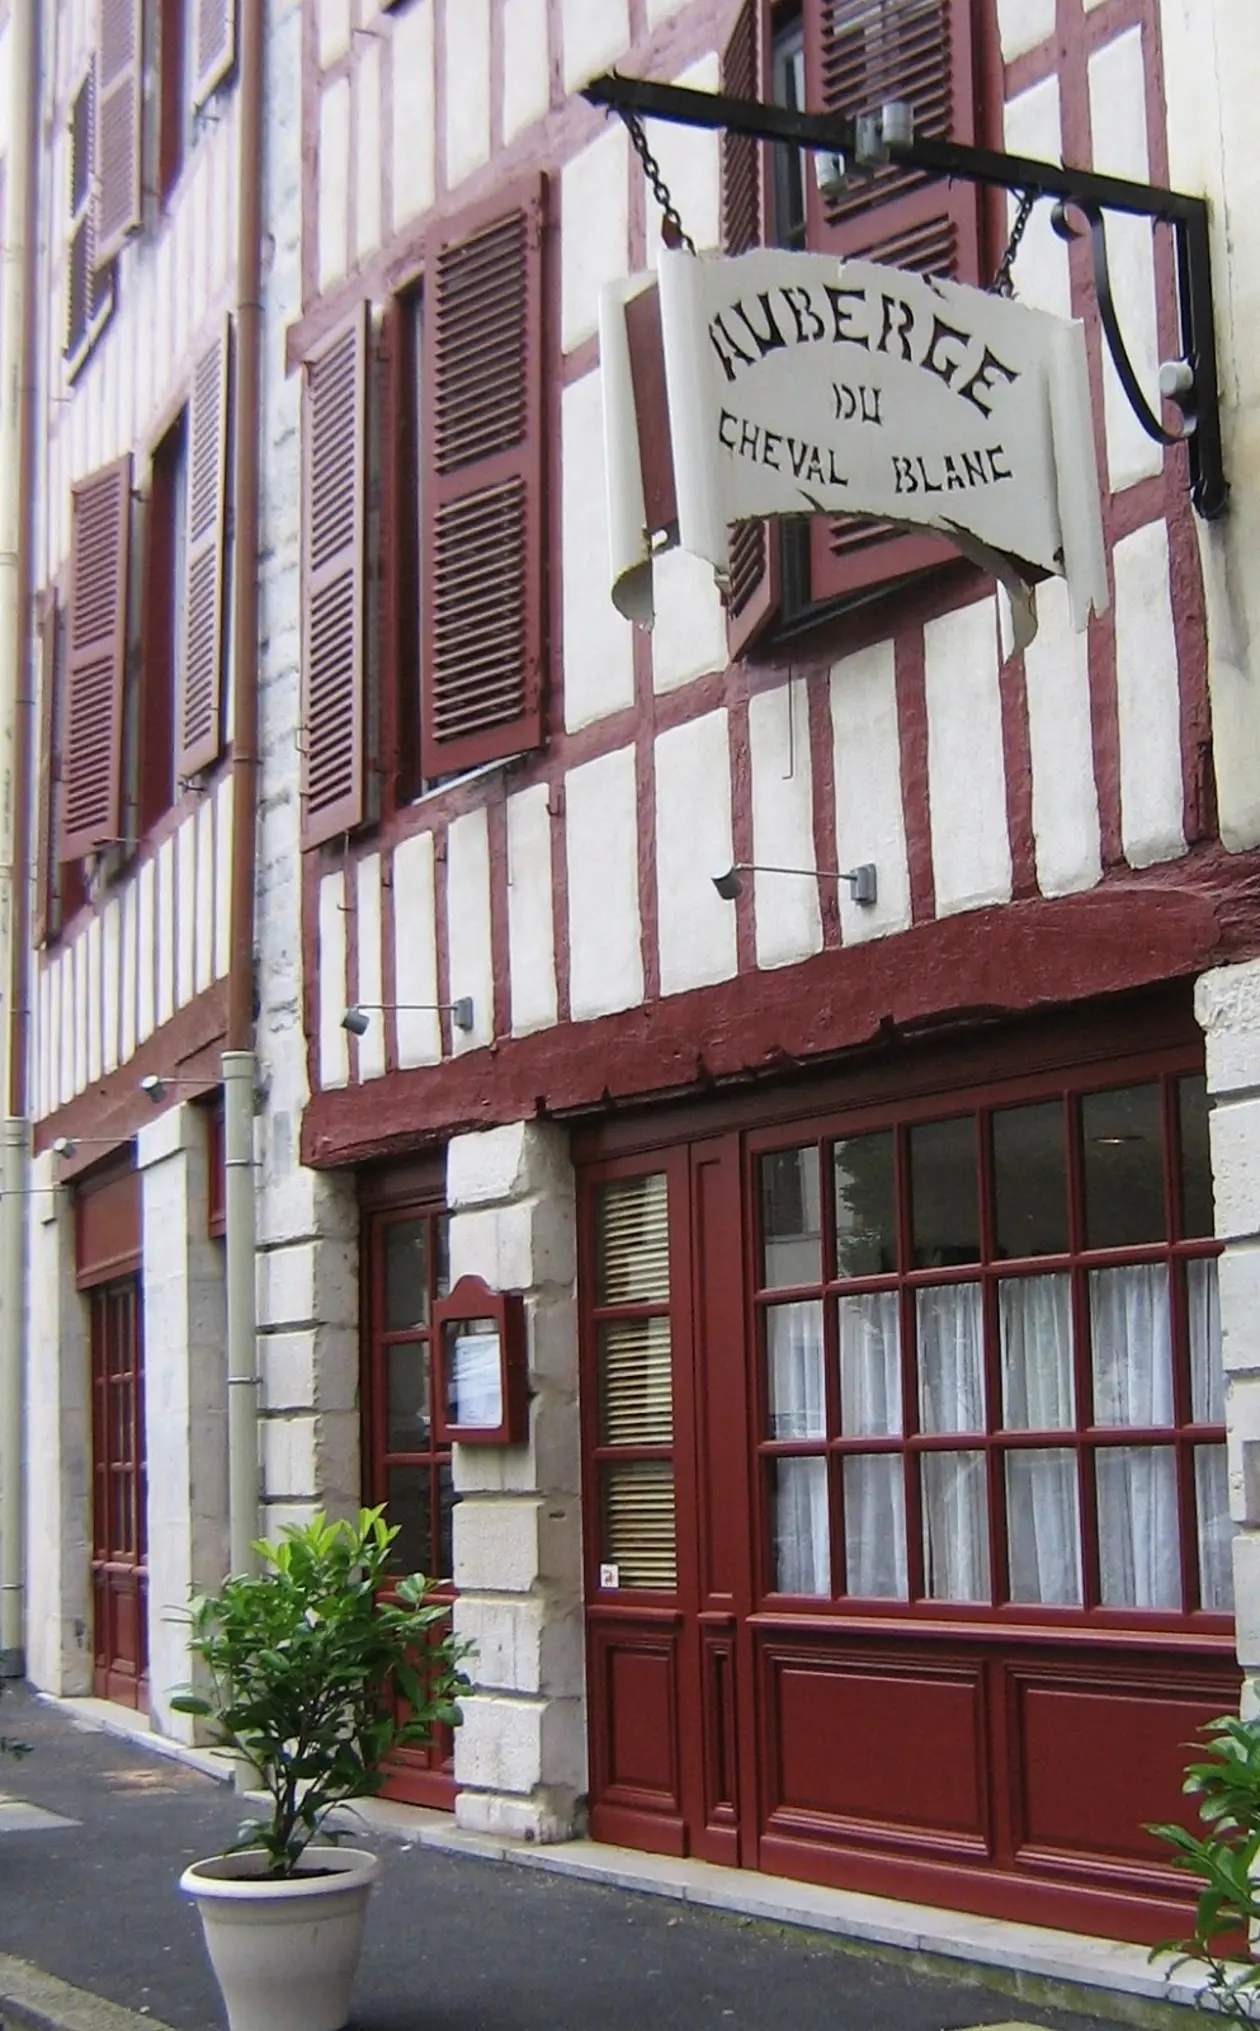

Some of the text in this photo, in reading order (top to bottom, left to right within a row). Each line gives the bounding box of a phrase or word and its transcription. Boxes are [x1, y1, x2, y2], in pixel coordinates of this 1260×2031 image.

[708, 283, 1022, 420] AUBERGE
[832, 383, 884, 427] DU
[718, 406, 1013, 494] CHEVAL BLANC
